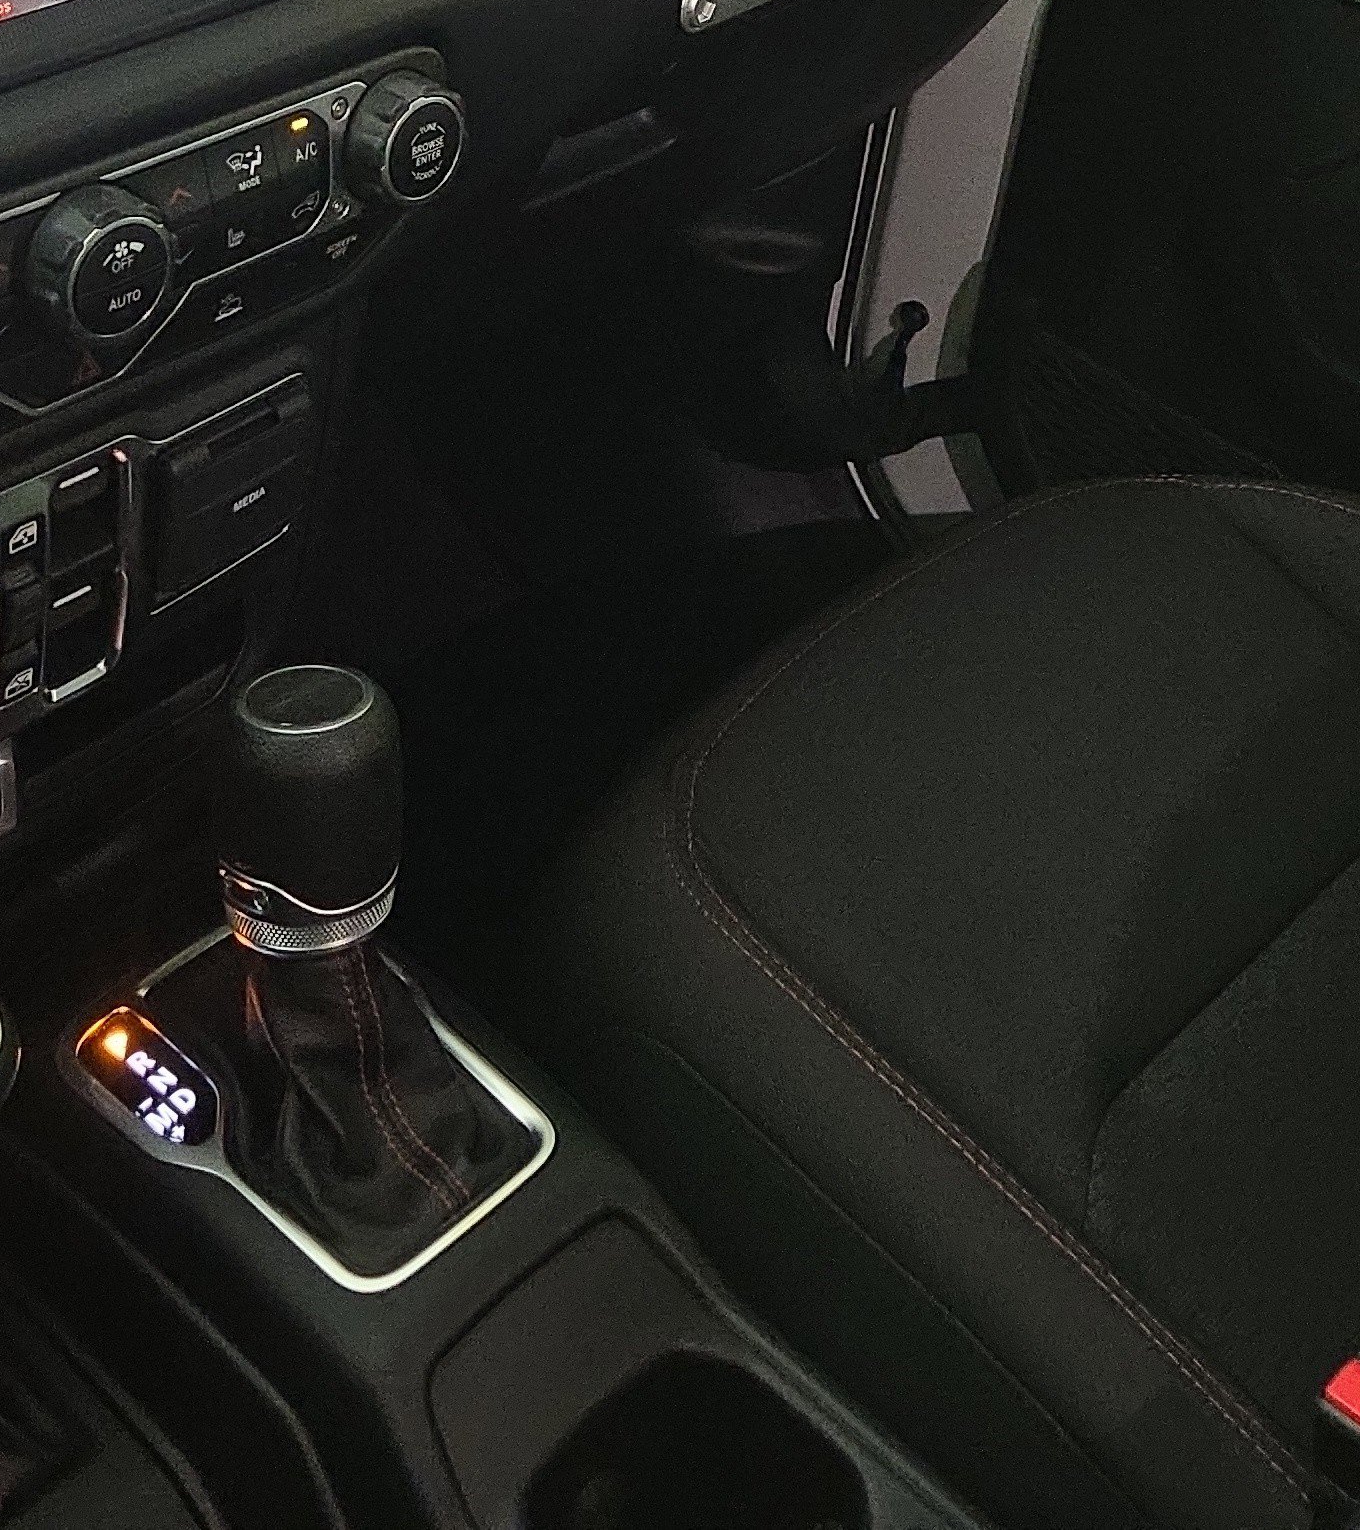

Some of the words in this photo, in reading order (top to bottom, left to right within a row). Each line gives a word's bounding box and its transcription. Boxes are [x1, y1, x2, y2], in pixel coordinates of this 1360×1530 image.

[296, 141, 318, 162] A/C
[412, 135, 445, 156] BROWSE
[416, 150, 441, 166] ENTER
[238, 176, 261, 192] MODE
[112, 254, 135, 273] OFF
[108, 289, 141, 312] AUTO
[233, 486, 265, 512] MEDIA
[126, 1051, 156, 1077] R
[147, 1066, 178, 1095] N
[168, 1088, 196, 1115] D
